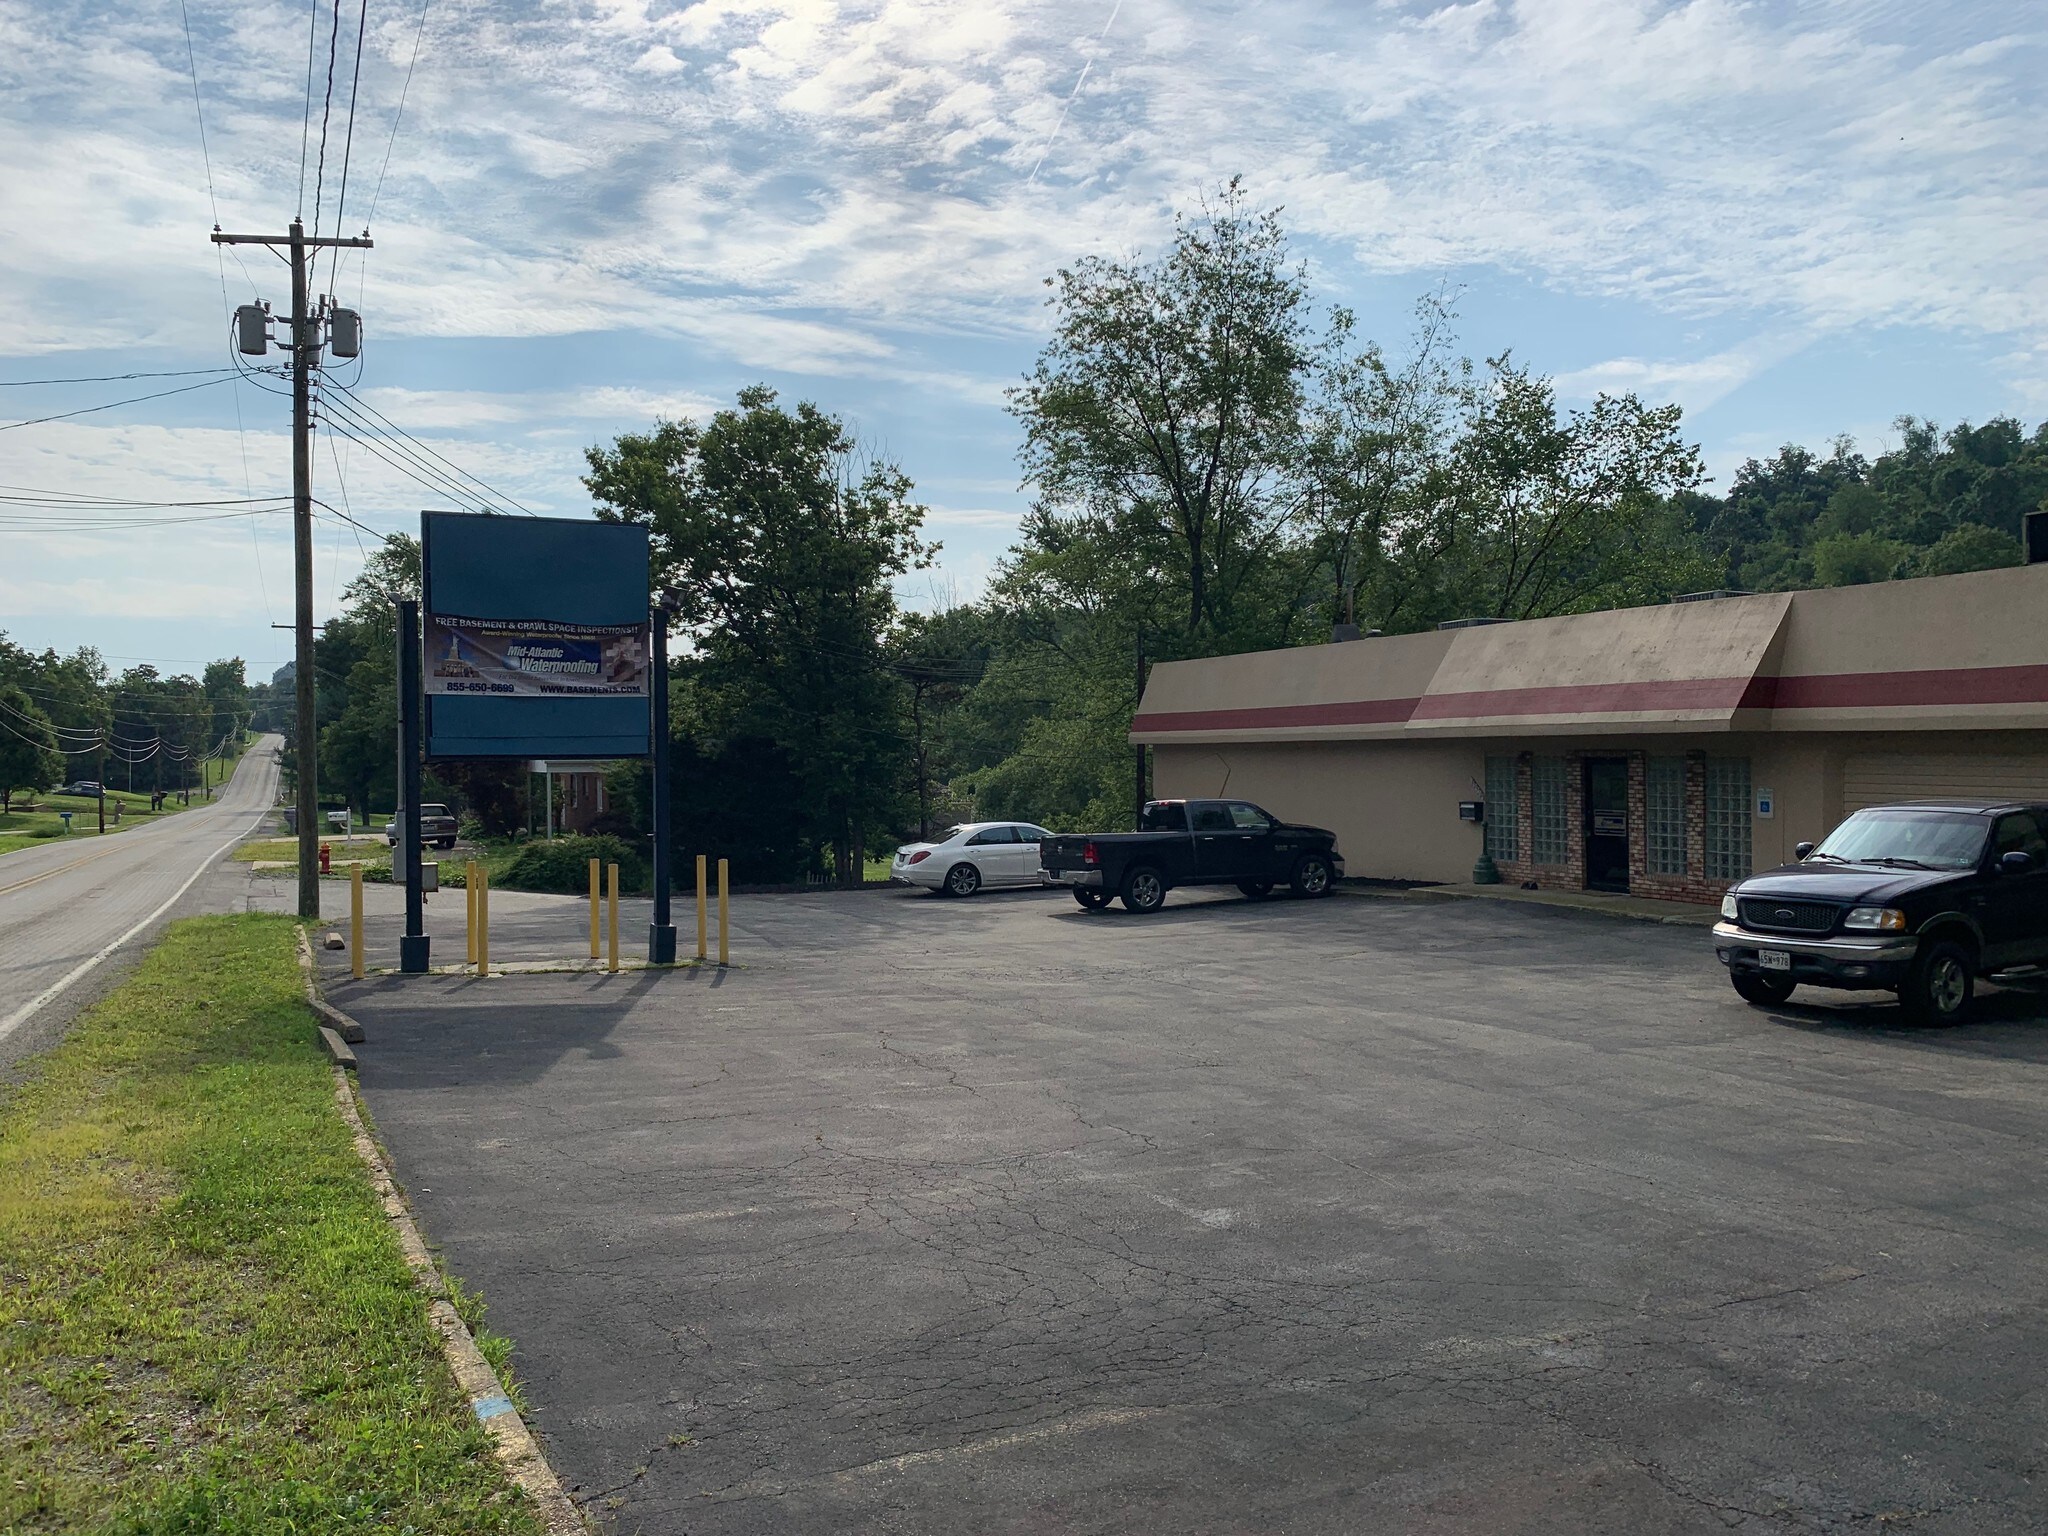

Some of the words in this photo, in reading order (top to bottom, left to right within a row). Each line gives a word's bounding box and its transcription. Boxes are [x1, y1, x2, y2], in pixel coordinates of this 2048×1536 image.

[435, 617, 458, 627] FREE
[459, 619, 506, 629] BASEMENT
[517, 622, 548, 630] CRAWL
[548, 623, 576, 633] SPACE
[577, 625, 638, 634] INSPECTIONS!!
[507, 645, 564, 658] Mid-Atlantic
[521, 658, 599, 675] Waterproofing
[540, 685, 641, 694] WWW.BASEMENTS.COM
